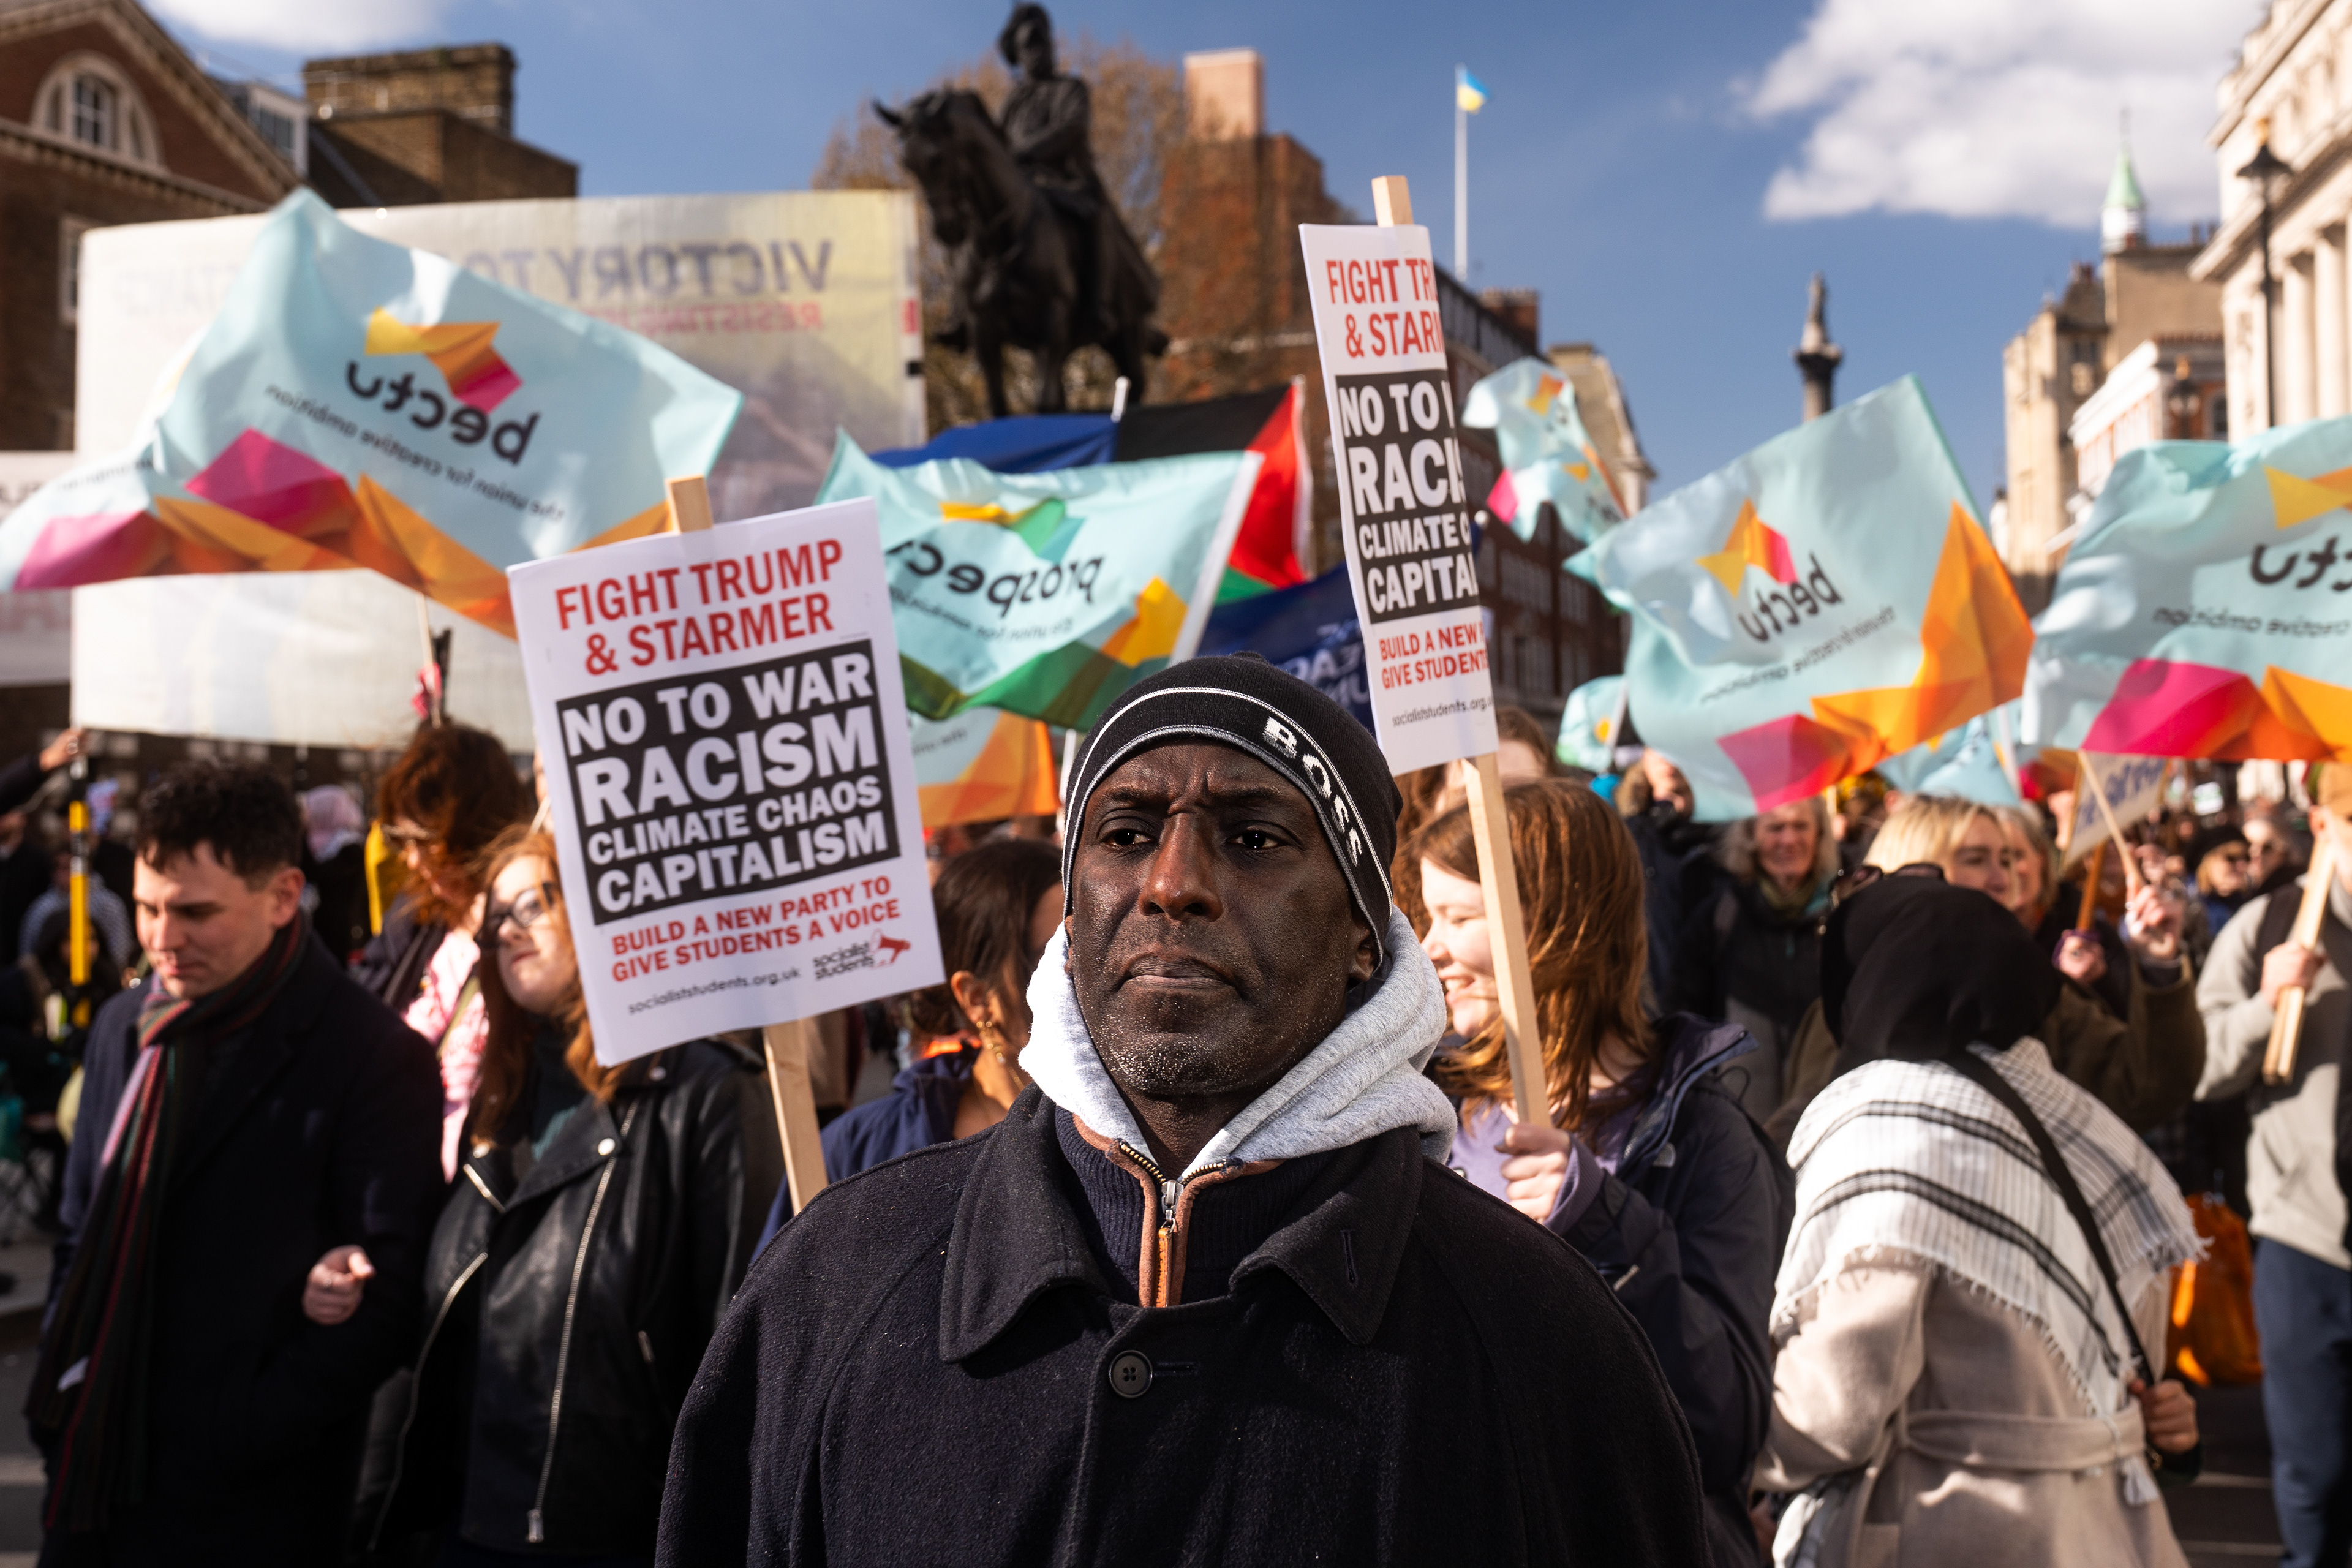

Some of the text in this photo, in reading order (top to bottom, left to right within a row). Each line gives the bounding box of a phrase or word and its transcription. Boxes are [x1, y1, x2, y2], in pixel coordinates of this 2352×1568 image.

[1326, 259, 1399, 304] FIGHT
[1345, 314, 1365, 358] &
[1338, 385, 1385, 437] NO
[1389, 380, 1440, 433] TO
[1359, 512, 1460, 560] CLIMATE
[555, 539, 842, 630] FIGHT TRUMP
[585, 633, 619, 675] &
[628, 592, 834, 667] STARMER
[1379, 633, 1420, 661] BUILD
[1425, 630, 1434, 652] A
[1437, 624, 1477, 650] NEW
[562, 653, 873, 756] NO TO WAR
[1382, 663, 1412, 690] GIVE
[576, 705, 879, 827] RACISM
[1262, 716, 1362, 867] BOSS
[588, 775, 882, 865] CLIMATE CHAOS
[597, 812, 888, 913] CAPITALISM
[612, 876, 891, 956] BUILD A NEW PARTY TO
[612, 899, 900, 982] GIVE STUDENTS A VOICE
[813, 941, 870, 968] socialist
[815, 954, 874, 981] students
[628, 967, 801, 1015] socialiststudents.org.uk
